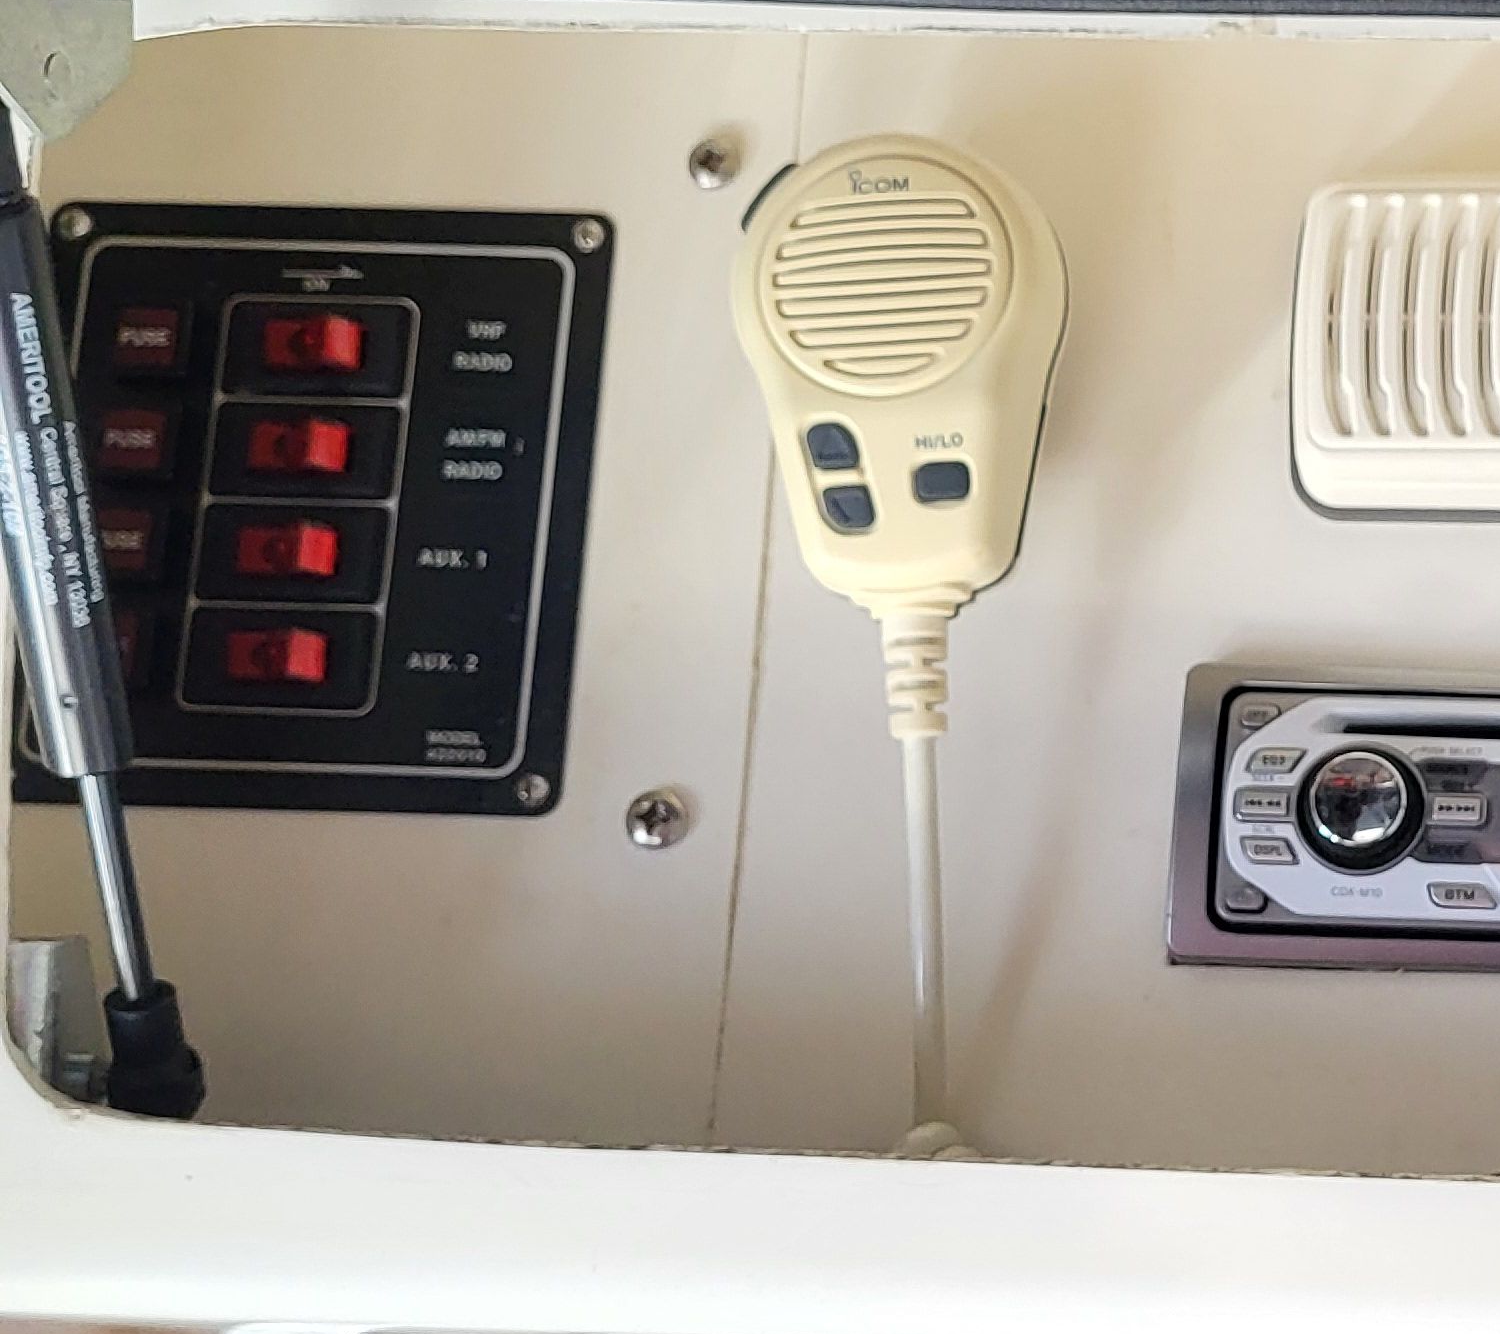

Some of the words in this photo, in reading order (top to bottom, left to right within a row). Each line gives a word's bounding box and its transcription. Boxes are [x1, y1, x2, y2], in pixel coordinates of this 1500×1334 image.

[10, 292, 53, 425] AMERITOOL
[452, 351, 513, 372] RADIO
[914, 432, 965, 450] HI/LO
[442, 459, 503, 480] RADIO
[475, 549, 488, 570] 1
[462, 653, 479, 674] 2
